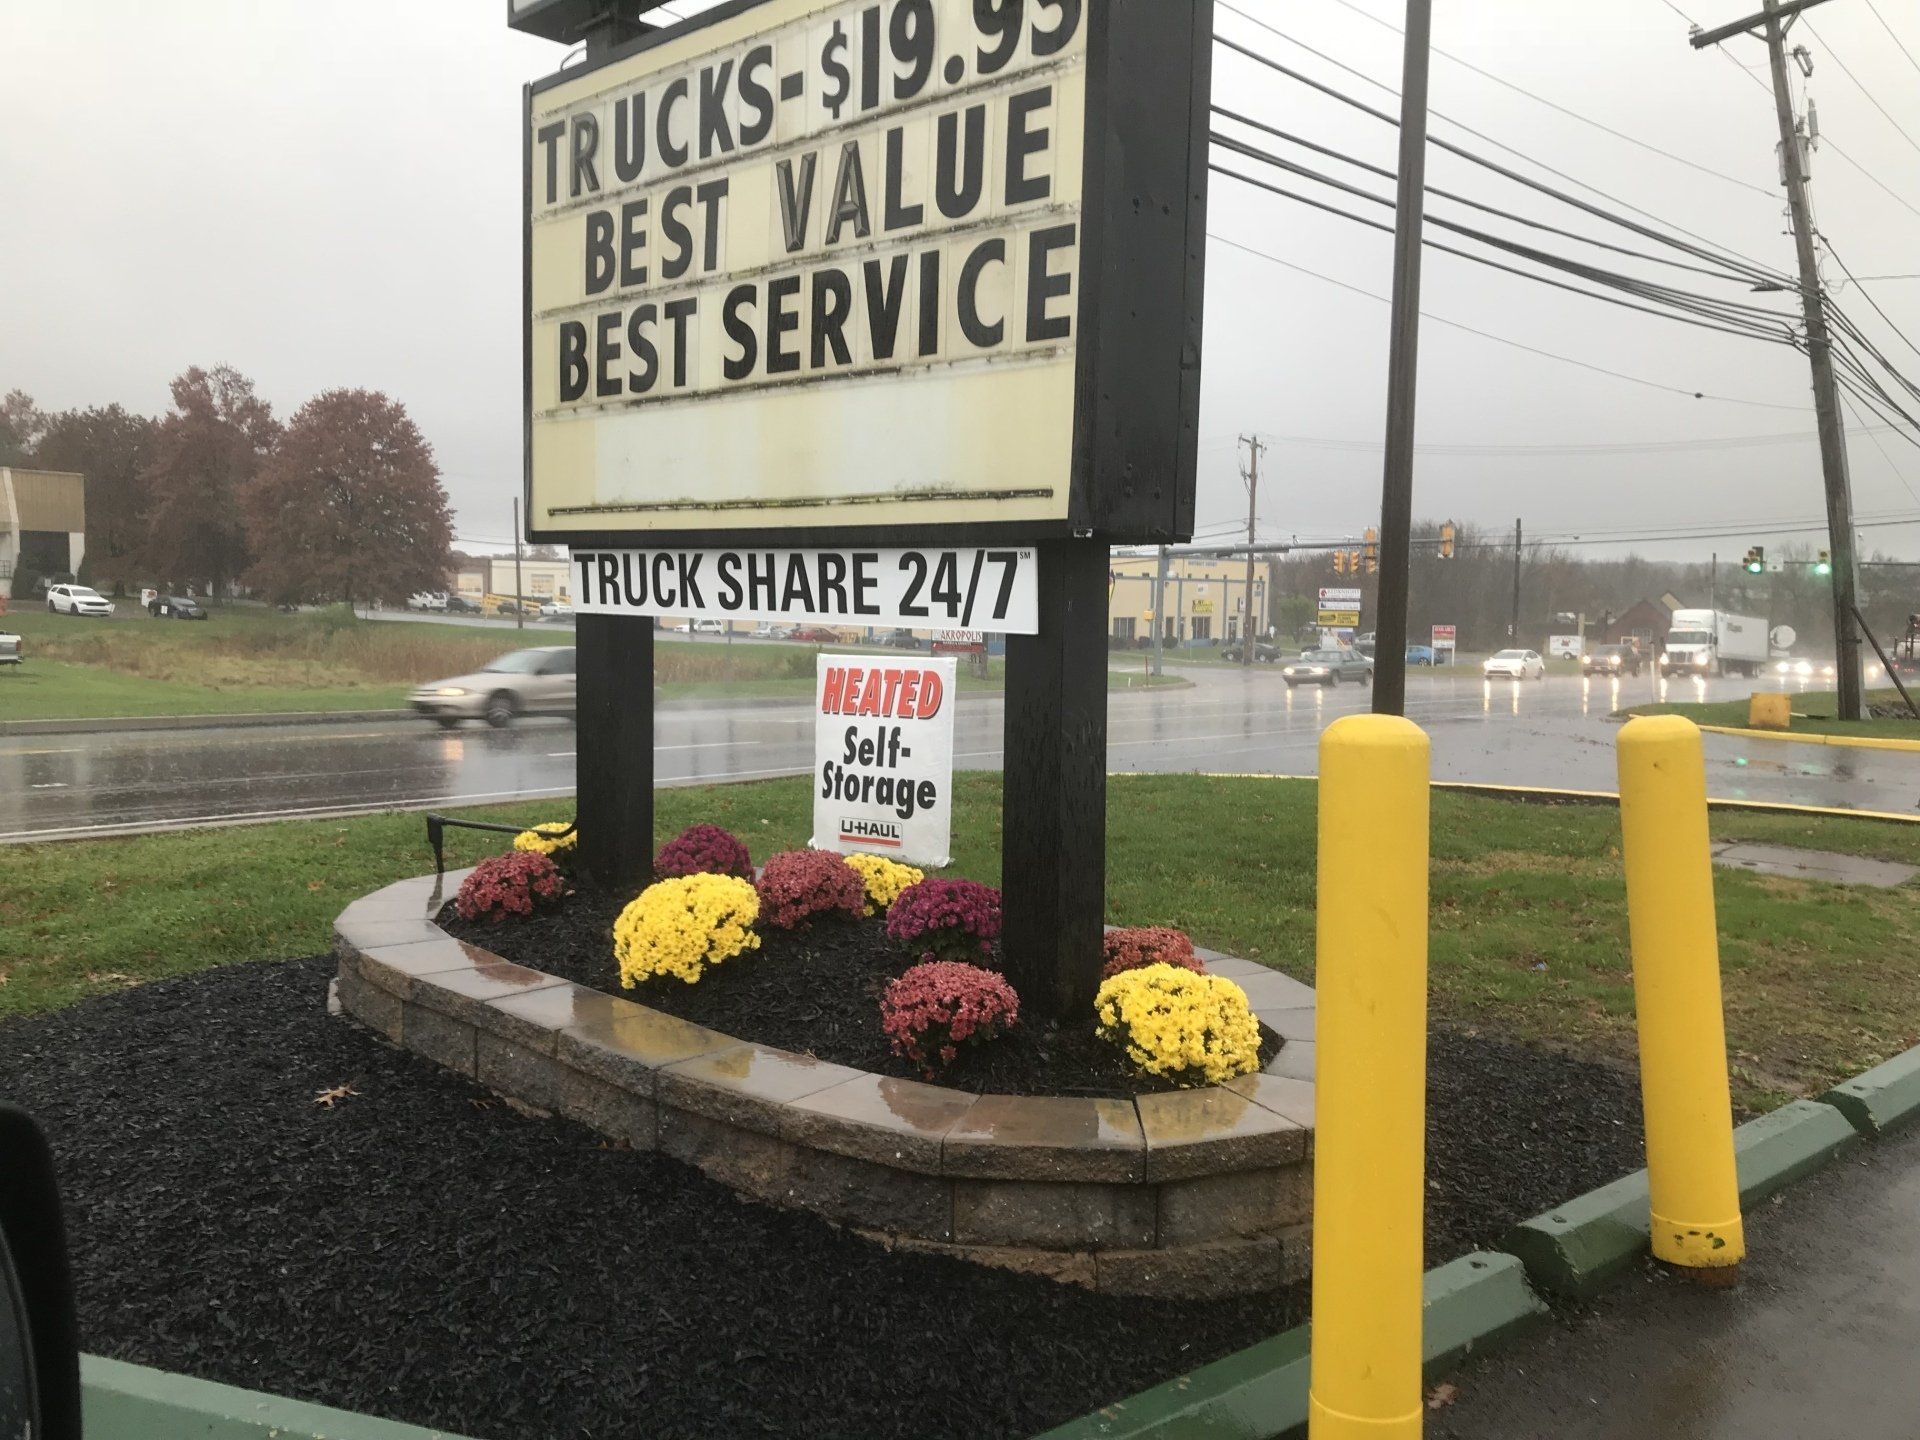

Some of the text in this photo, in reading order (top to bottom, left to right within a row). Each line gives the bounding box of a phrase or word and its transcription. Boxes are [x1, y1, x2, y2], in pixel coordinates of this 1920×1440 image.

[585, 85, 1053, 296] BEST VALUE
[559, 223, 1077, 403] BEST SERVICE
[574, 552, 706, 609] TRUCK
[717, 551, 881, 616] SHARE
[898, 549, 1018, 627] 24/7
[940, 629, 982, 642] AKROPOLIS
[821, 667, 943, 720] HEATED
[843, 725, 911, 768] Self-
[822, 760, 937, 819] Storage
[841, 820, 900, 838] U-HAUL
